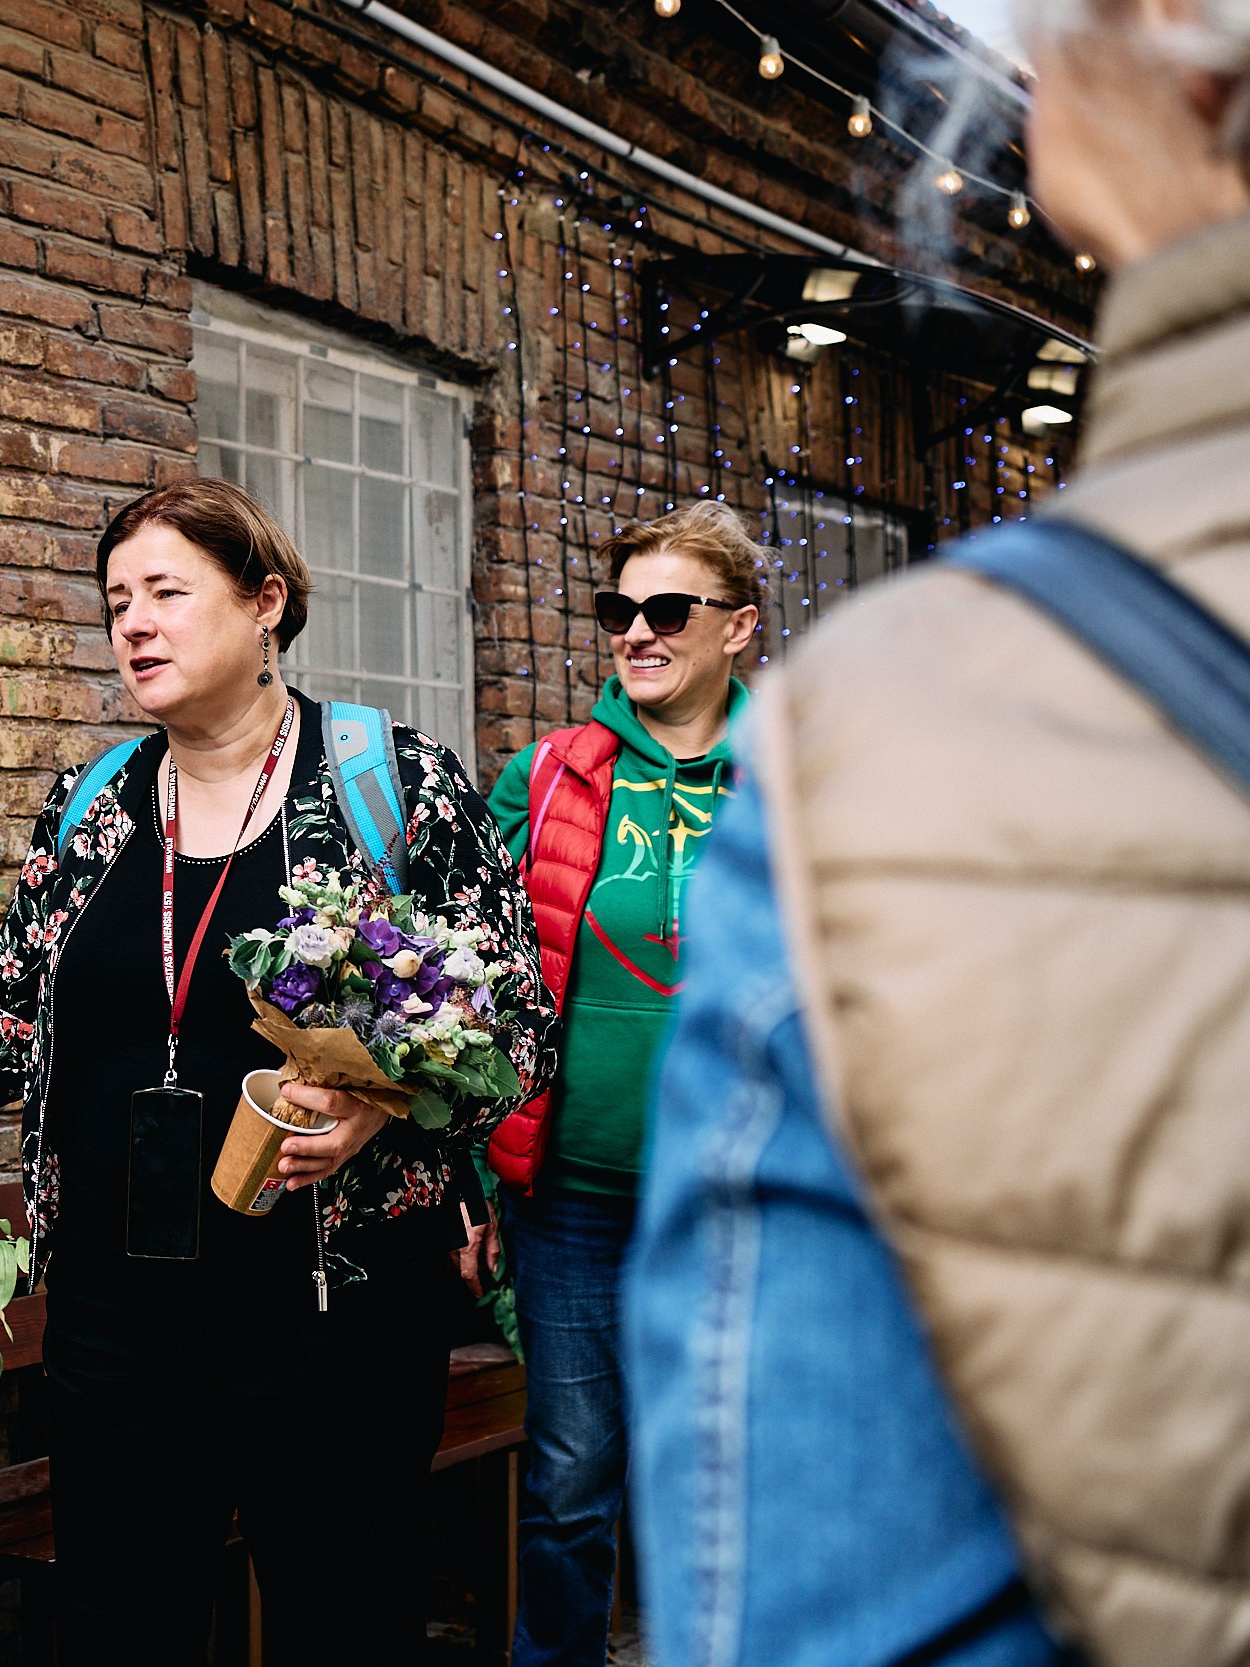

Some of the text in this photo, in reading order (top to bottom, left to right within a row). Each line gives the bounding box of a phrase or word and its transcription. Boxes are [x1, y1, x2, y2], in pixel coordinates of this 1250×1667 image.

[271, 737, 284, 757] 1579
[167, 772, 176, 821] UNIVERSITAS
[163, 890, 172, 910] 1579
[163, 911, 172, 955] VILNENSIS
